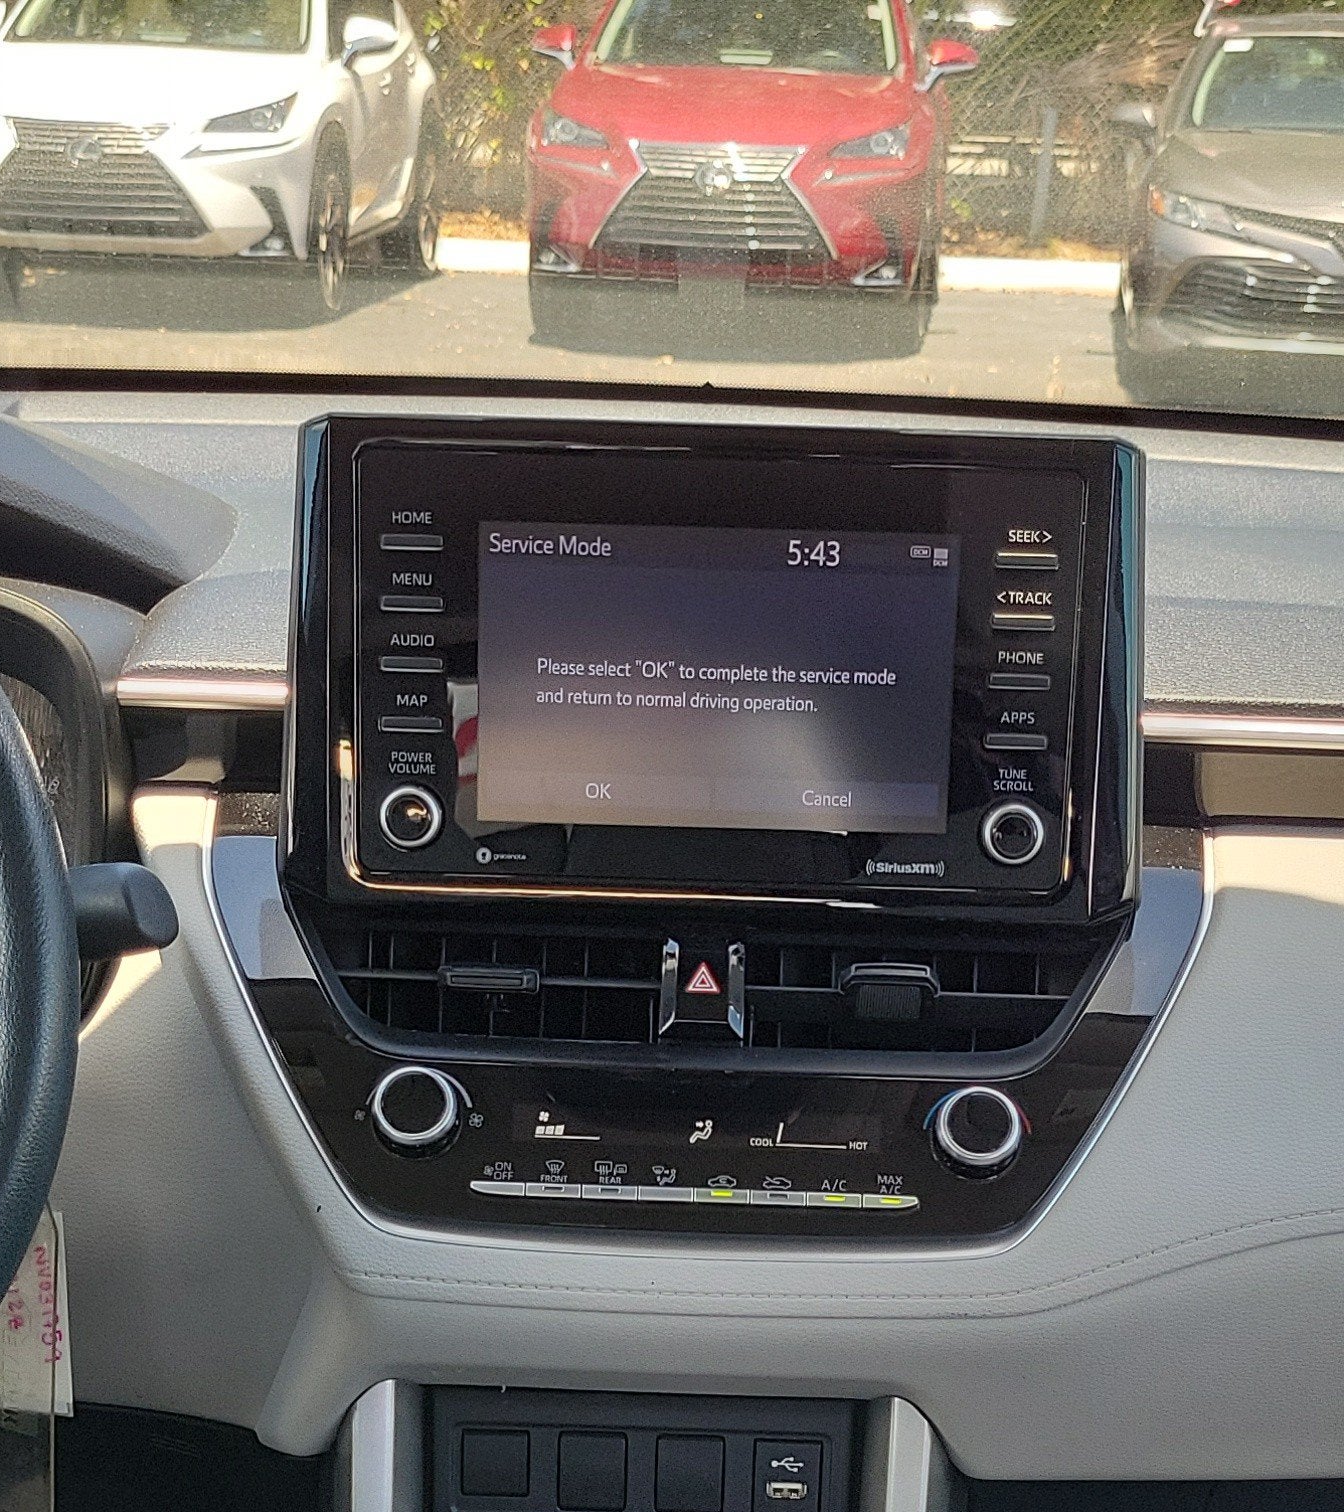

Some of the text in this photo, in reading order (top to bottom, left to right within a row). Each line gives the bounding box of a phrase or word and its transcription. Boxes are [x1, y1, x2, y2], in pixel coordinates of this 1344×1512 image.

[391, 511, 432, 525] HOME
[489, 532, 612, 557] Service Mode
[787, 540, 841, 567] 5:43
[932, 559, 948, 567] DCM
[392, 572, 433, 586] MENU
[390, 633, 435, 647] AUDIO
[997, 651, 1044, 666] PHONE
[537, 657, 897, 686] Please select "OK" to complete the service mode
[396, 694, 428, 708] MAP
[536, 687, 818, 714] and return to normal driving operation.
[1000, 711, 1035, 726] APPS
[391, 752, 432, 763] POWER
[388, 763, 436, 775] VOLUME
[998, 769, 1028, 780] TUNE
[585, 783, 612, 800] OK
[993, 780, 1034, 792] SCROLL
[802, 790, 852, 808] Cancel
[749, 1137, 774, 1147] COOL
[848, 1141, 869, 1151] HOT
[494, 1161, 512, 1171] ON
[493, 1171, 515, 1181] OFF
[539, 1174, 569, 1184] FRONT
[598, 1175, 622, 1184] REAR
[876, 1174, 904, 1186] MAX
[821, 1178, 848, 1192] A/C
[879, 1185, 902, 1195] A/C
